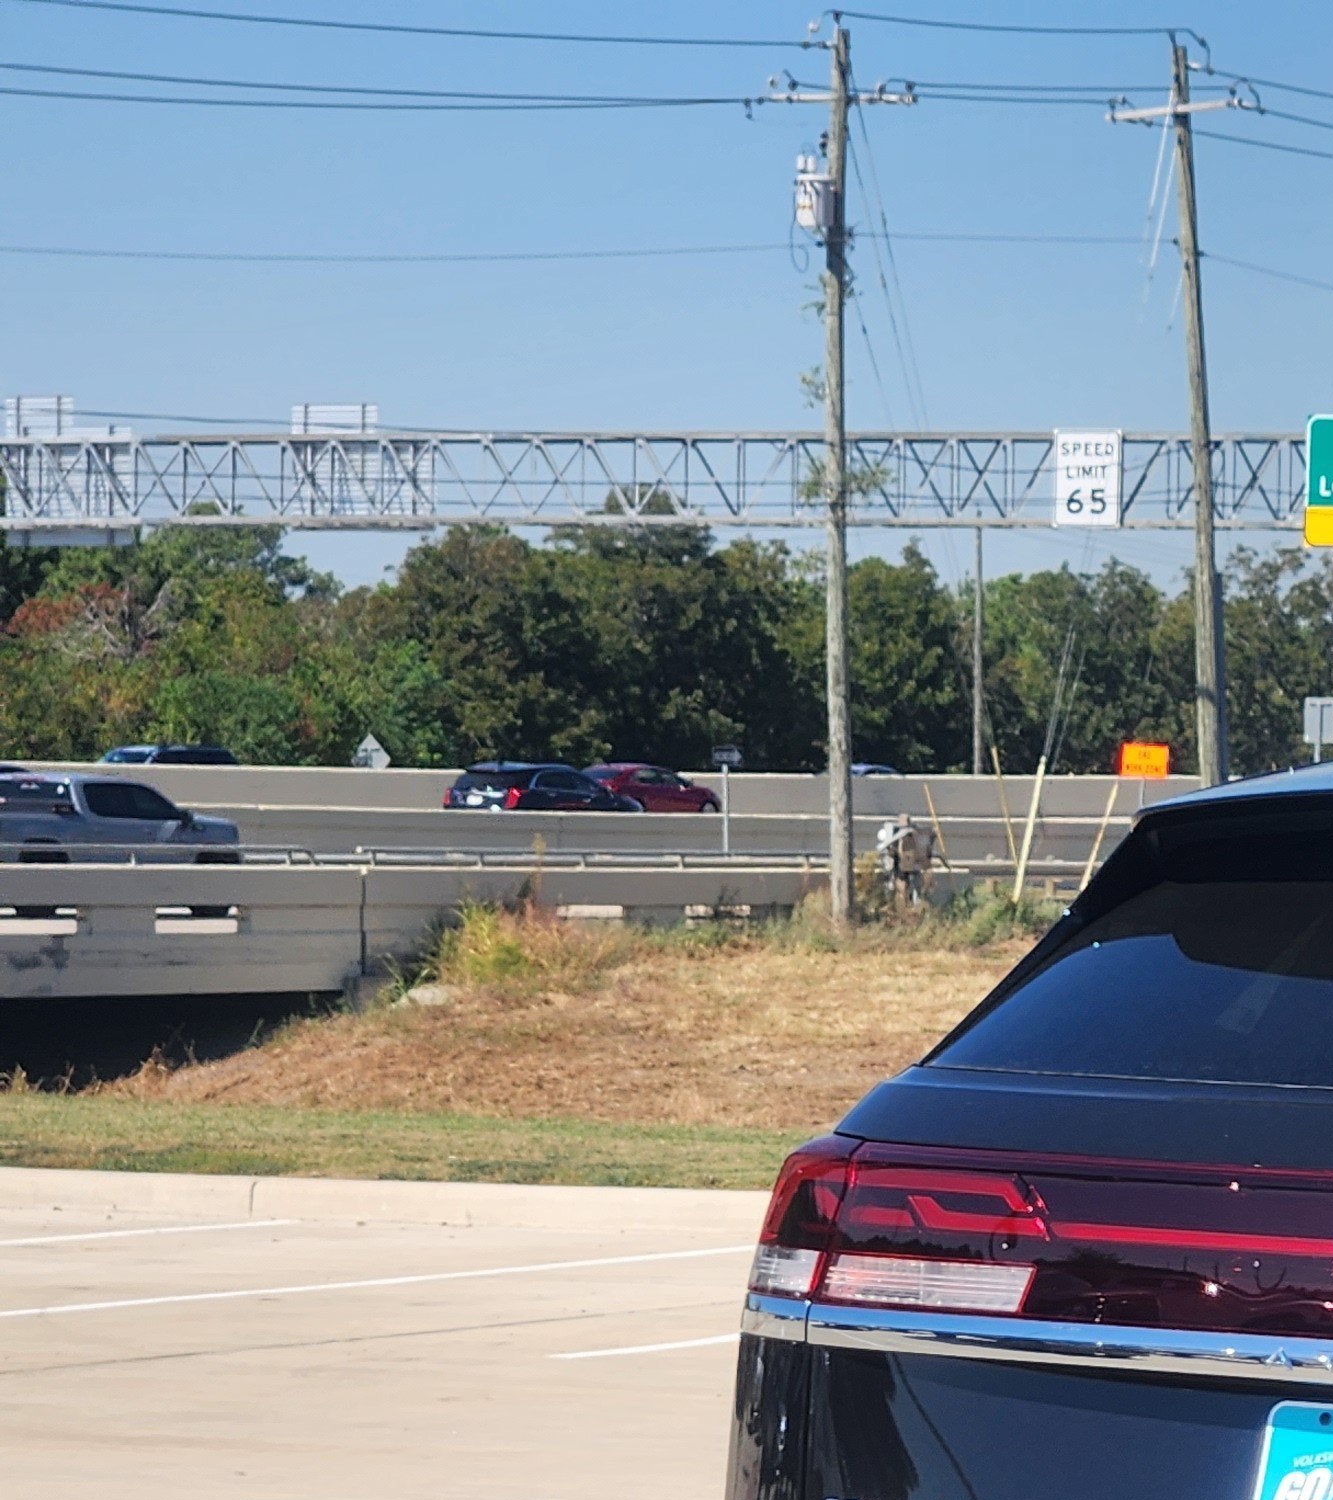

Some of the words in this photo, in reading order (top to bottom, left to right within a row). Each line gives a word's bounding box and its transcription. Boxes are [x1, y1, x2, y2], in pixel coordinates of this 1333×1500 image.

[1061, 443, 1114, 456] SPEED
[1066, 465, 1108, 479] LIMIT
[1066, 488, 1107, 514] 65
